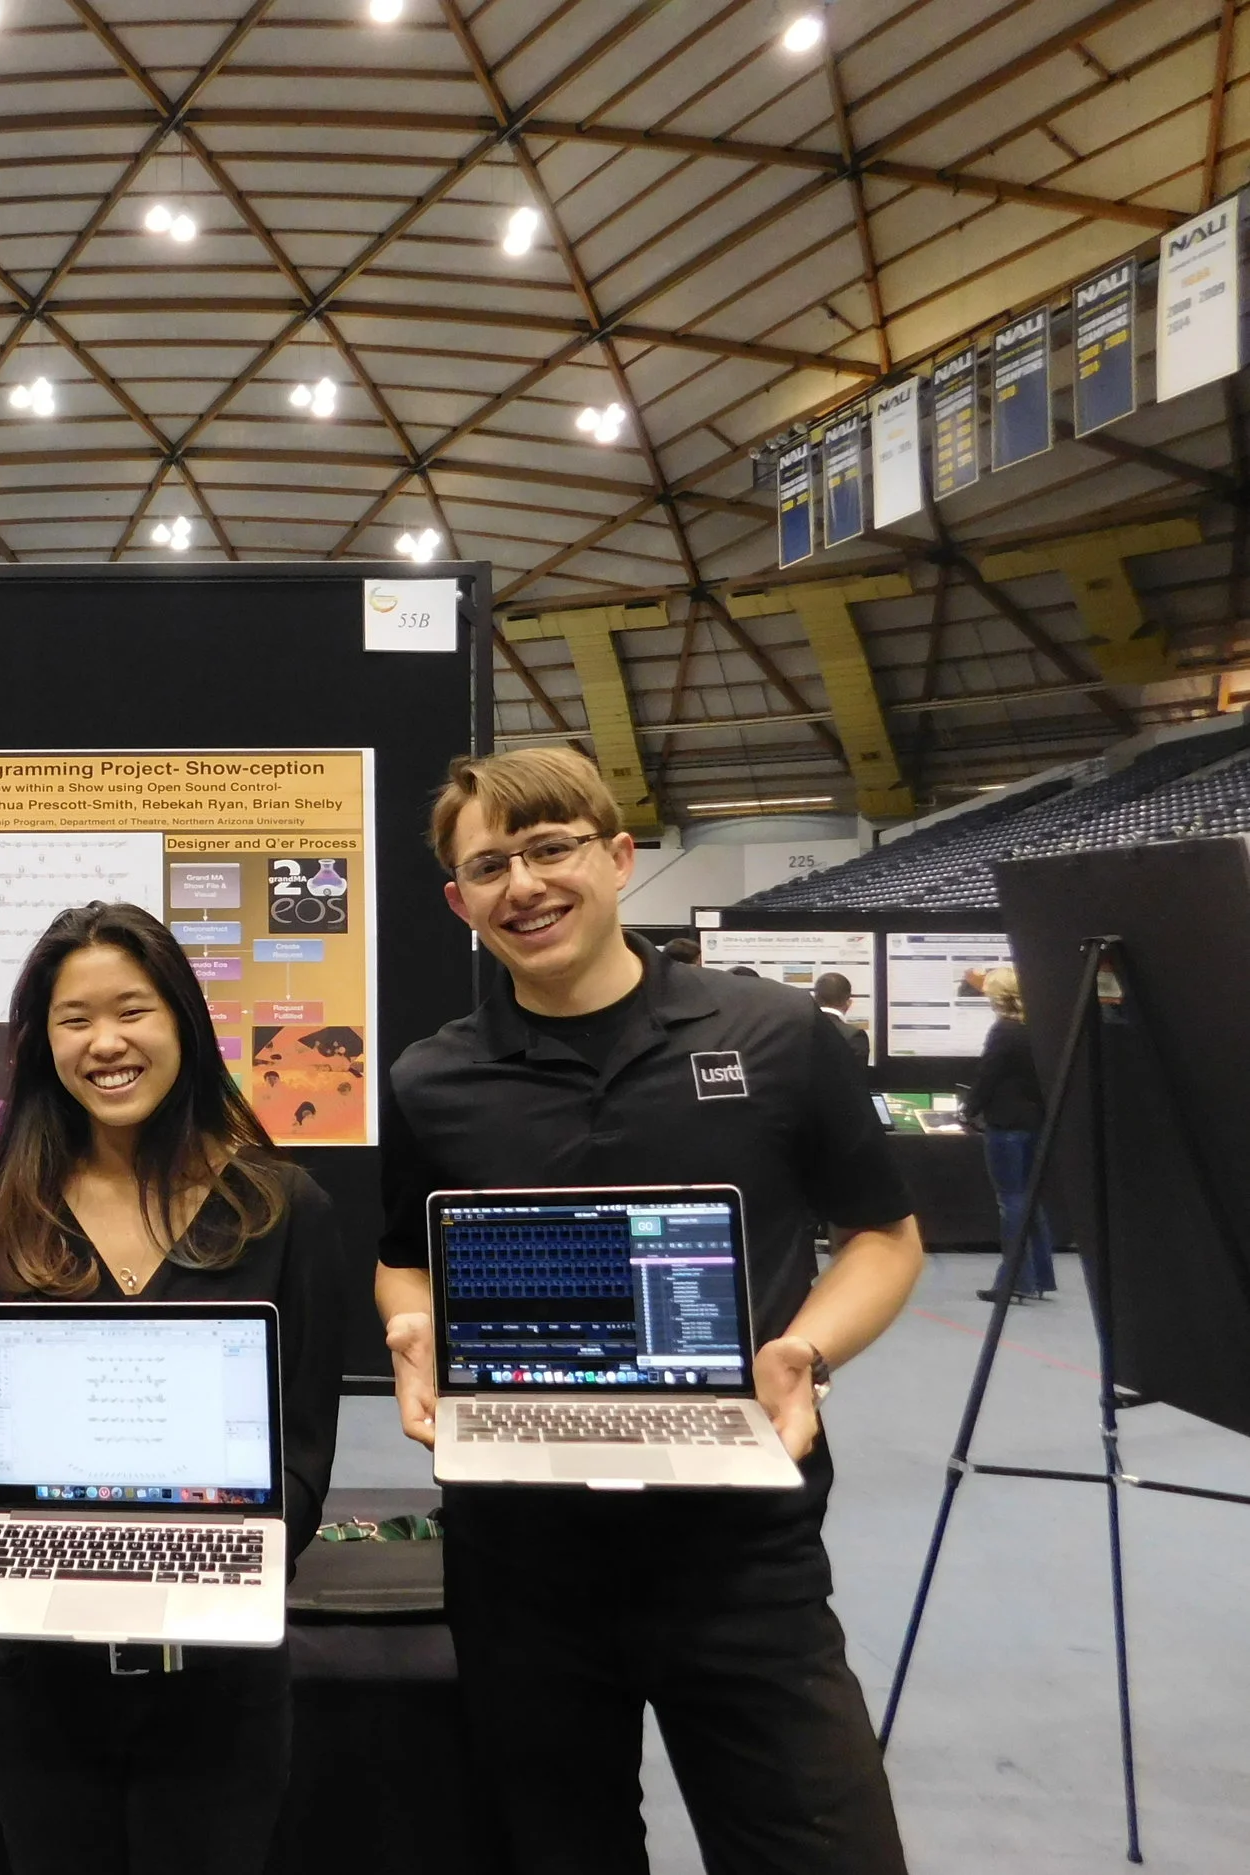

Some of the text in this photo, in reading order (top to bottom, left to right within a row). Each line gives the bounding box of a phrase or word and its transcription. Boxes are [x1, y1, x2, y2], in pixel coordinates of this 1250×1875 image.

[1169, 213, 1227, 258] NAU
[1077, 266, 1129, 308] NAU
[996, 313, 1044, 351] NAU
[934, 351, 973, 386] NAU
[878, 387, 912, 416] NAU
[826, 416, 858, 445] NAU
[780, 443, 808, 470] NAU
[397, 613, 431, 629] 55B
[101, 761, 179, 778] Project-
[186, 760, 325, 778] Show-ception
[16, 783, 54, 793] within
[69, 782, 104, 793] Show
[108, 782, 143, 794] using
[147, 782, 181, 794] Open
[185, 782, 226, 792] Sound
[230, 781, 282, 792] Control-
[28, 799, 137, 812] Prescott-Smith,
[142, 799, 203, 810] Rebekah
[208, 799, 248, 812] Ryan,
[253, 798, 290, 809] Brian
[294, 798, 343, 812] Shelby
[14, 818, 57, 828] Program,
[60, 818, 115, 827] Department
[118, 817, 128, 826] of
[131, 817, 170, 826] Theatre,
[173, 817, 215, 825] Northern
[217, 817, 253, 825] Arizona
[257, 817, 305, 826] University
[167, 838, 357, 850] Designer and Q'er Process
[788, 855, 815, 868] 225
[268, 875, 307, 884] grandMA
[270, 897, 346, 924] eos
